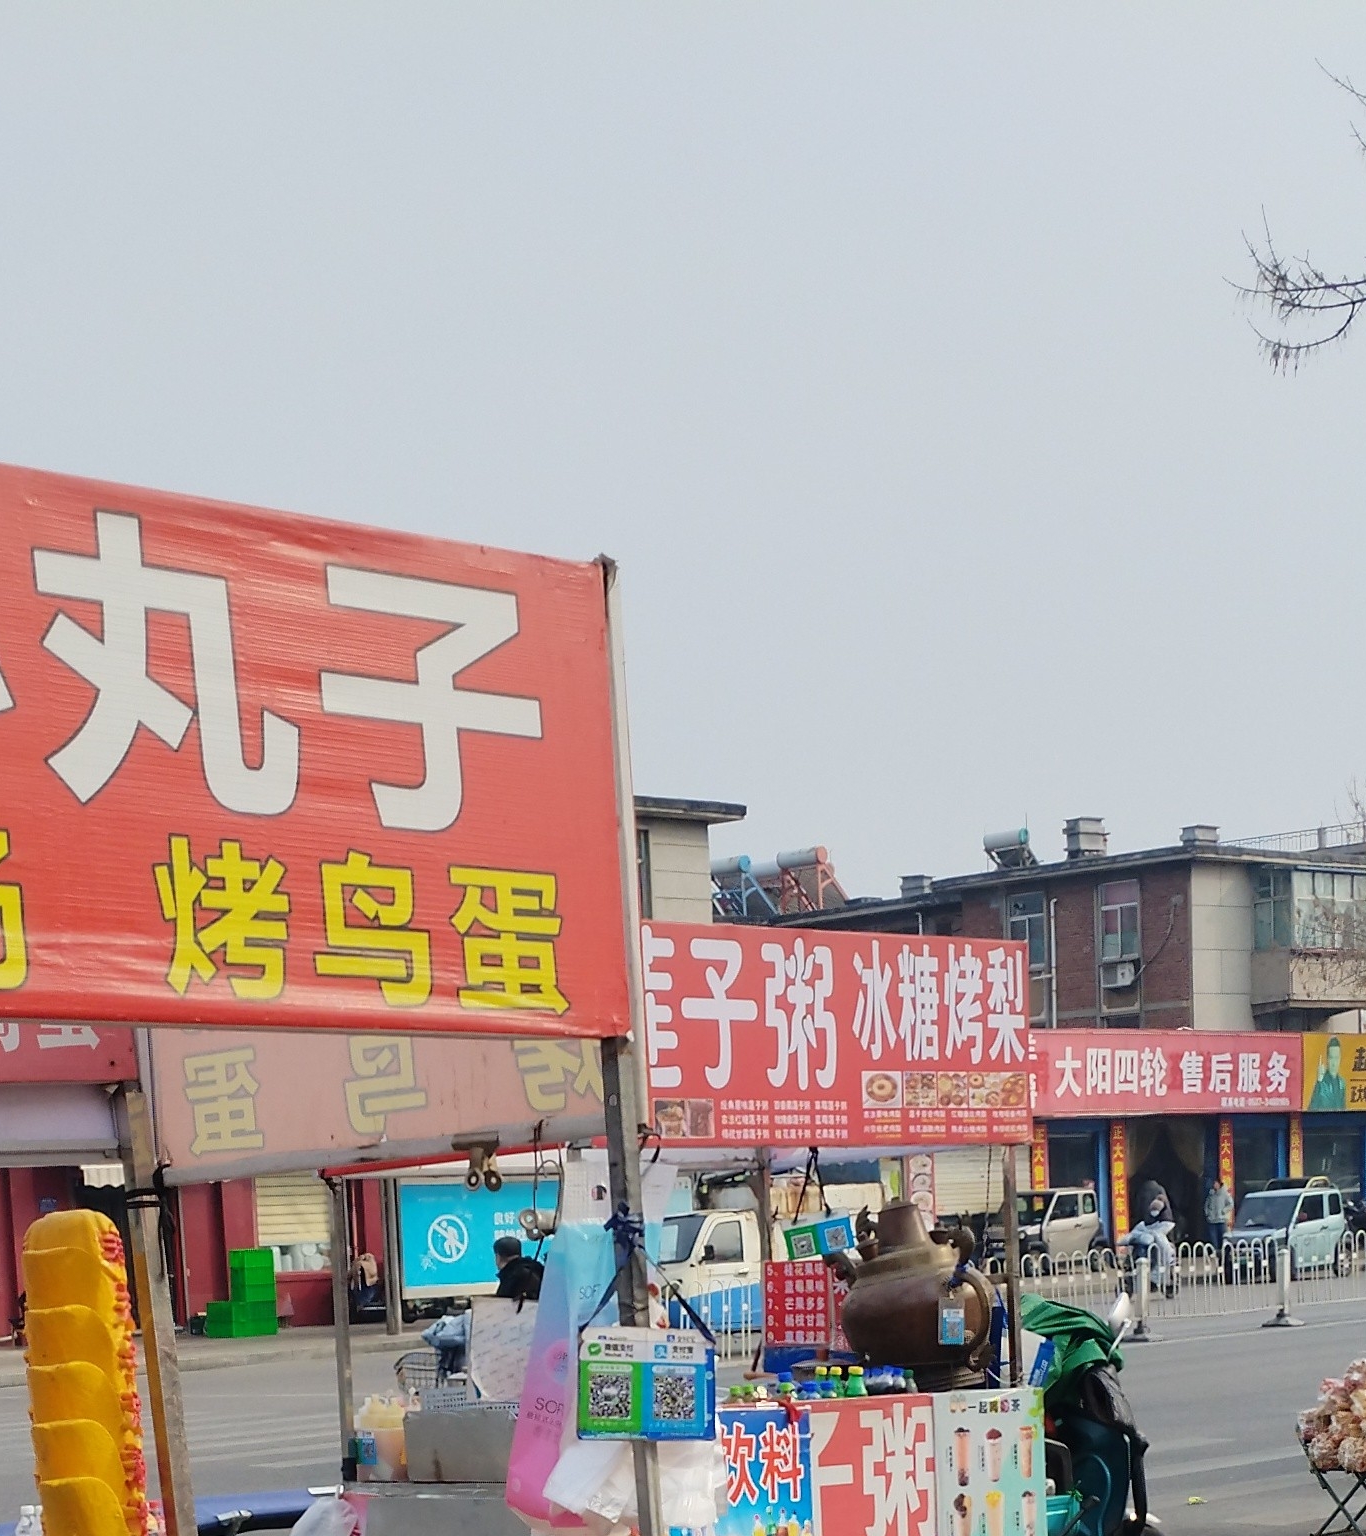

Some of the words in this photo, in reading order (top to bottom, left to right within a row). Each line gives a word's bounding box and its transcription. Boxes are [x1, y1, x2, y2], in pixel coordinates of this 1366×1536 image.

[153, 833, 571, 1017] 烤鸟蛋
[852, 940, 1027, 1064] 冰糖烤梨
[1054, 1046, 1168, 1098] 大阳四轮
[1179, 1050, 1290, 1094] 售后服务
